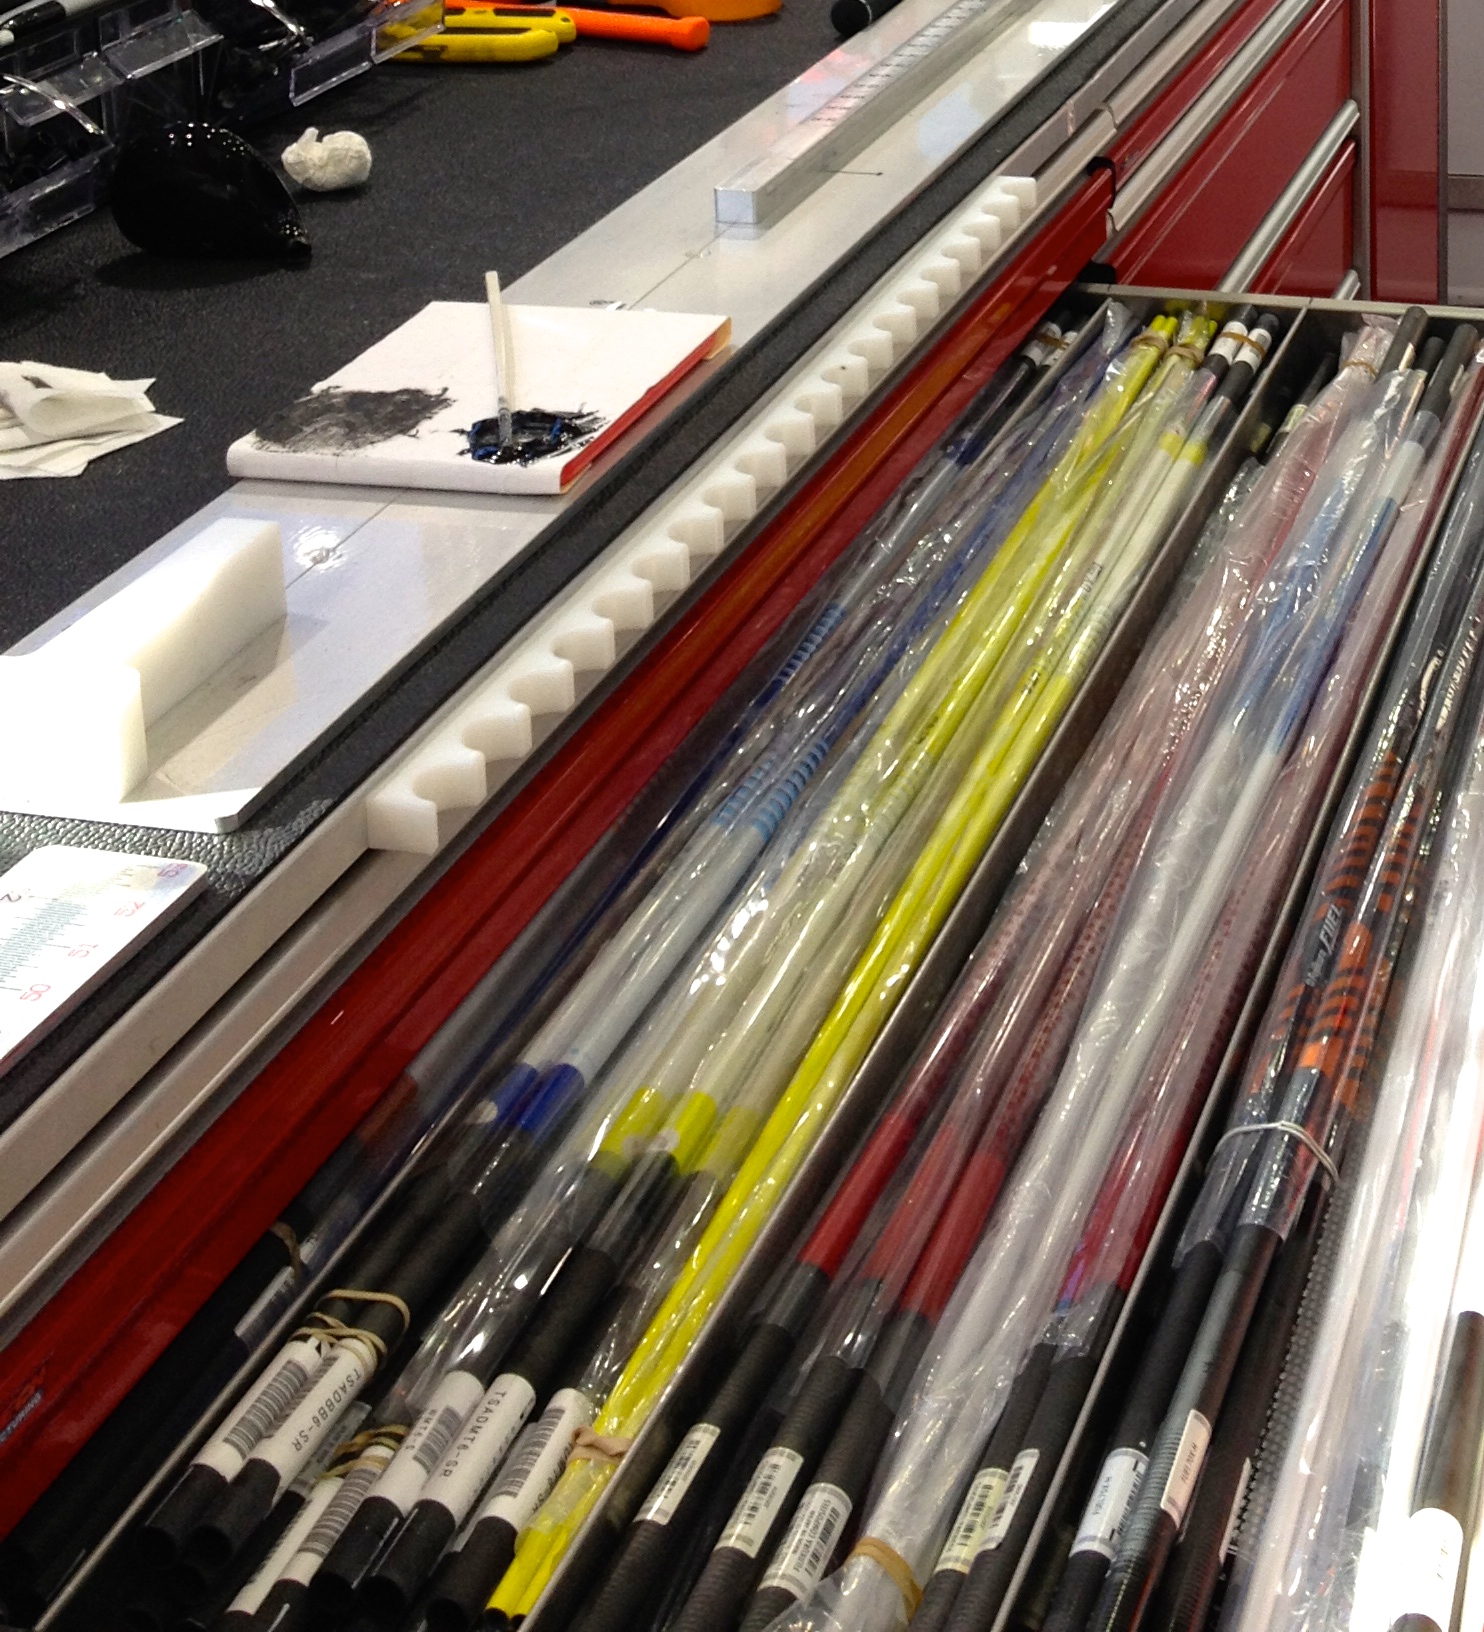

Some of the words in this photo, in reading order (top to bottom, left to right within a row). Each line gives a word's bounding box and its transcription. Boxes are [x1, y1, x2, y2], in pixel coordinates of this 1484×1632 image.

[68, 943, 98, 958] 51
[20, 983, 51, 1002] 50
[291, 1368, 361, 1452] TSADBB6-SR
